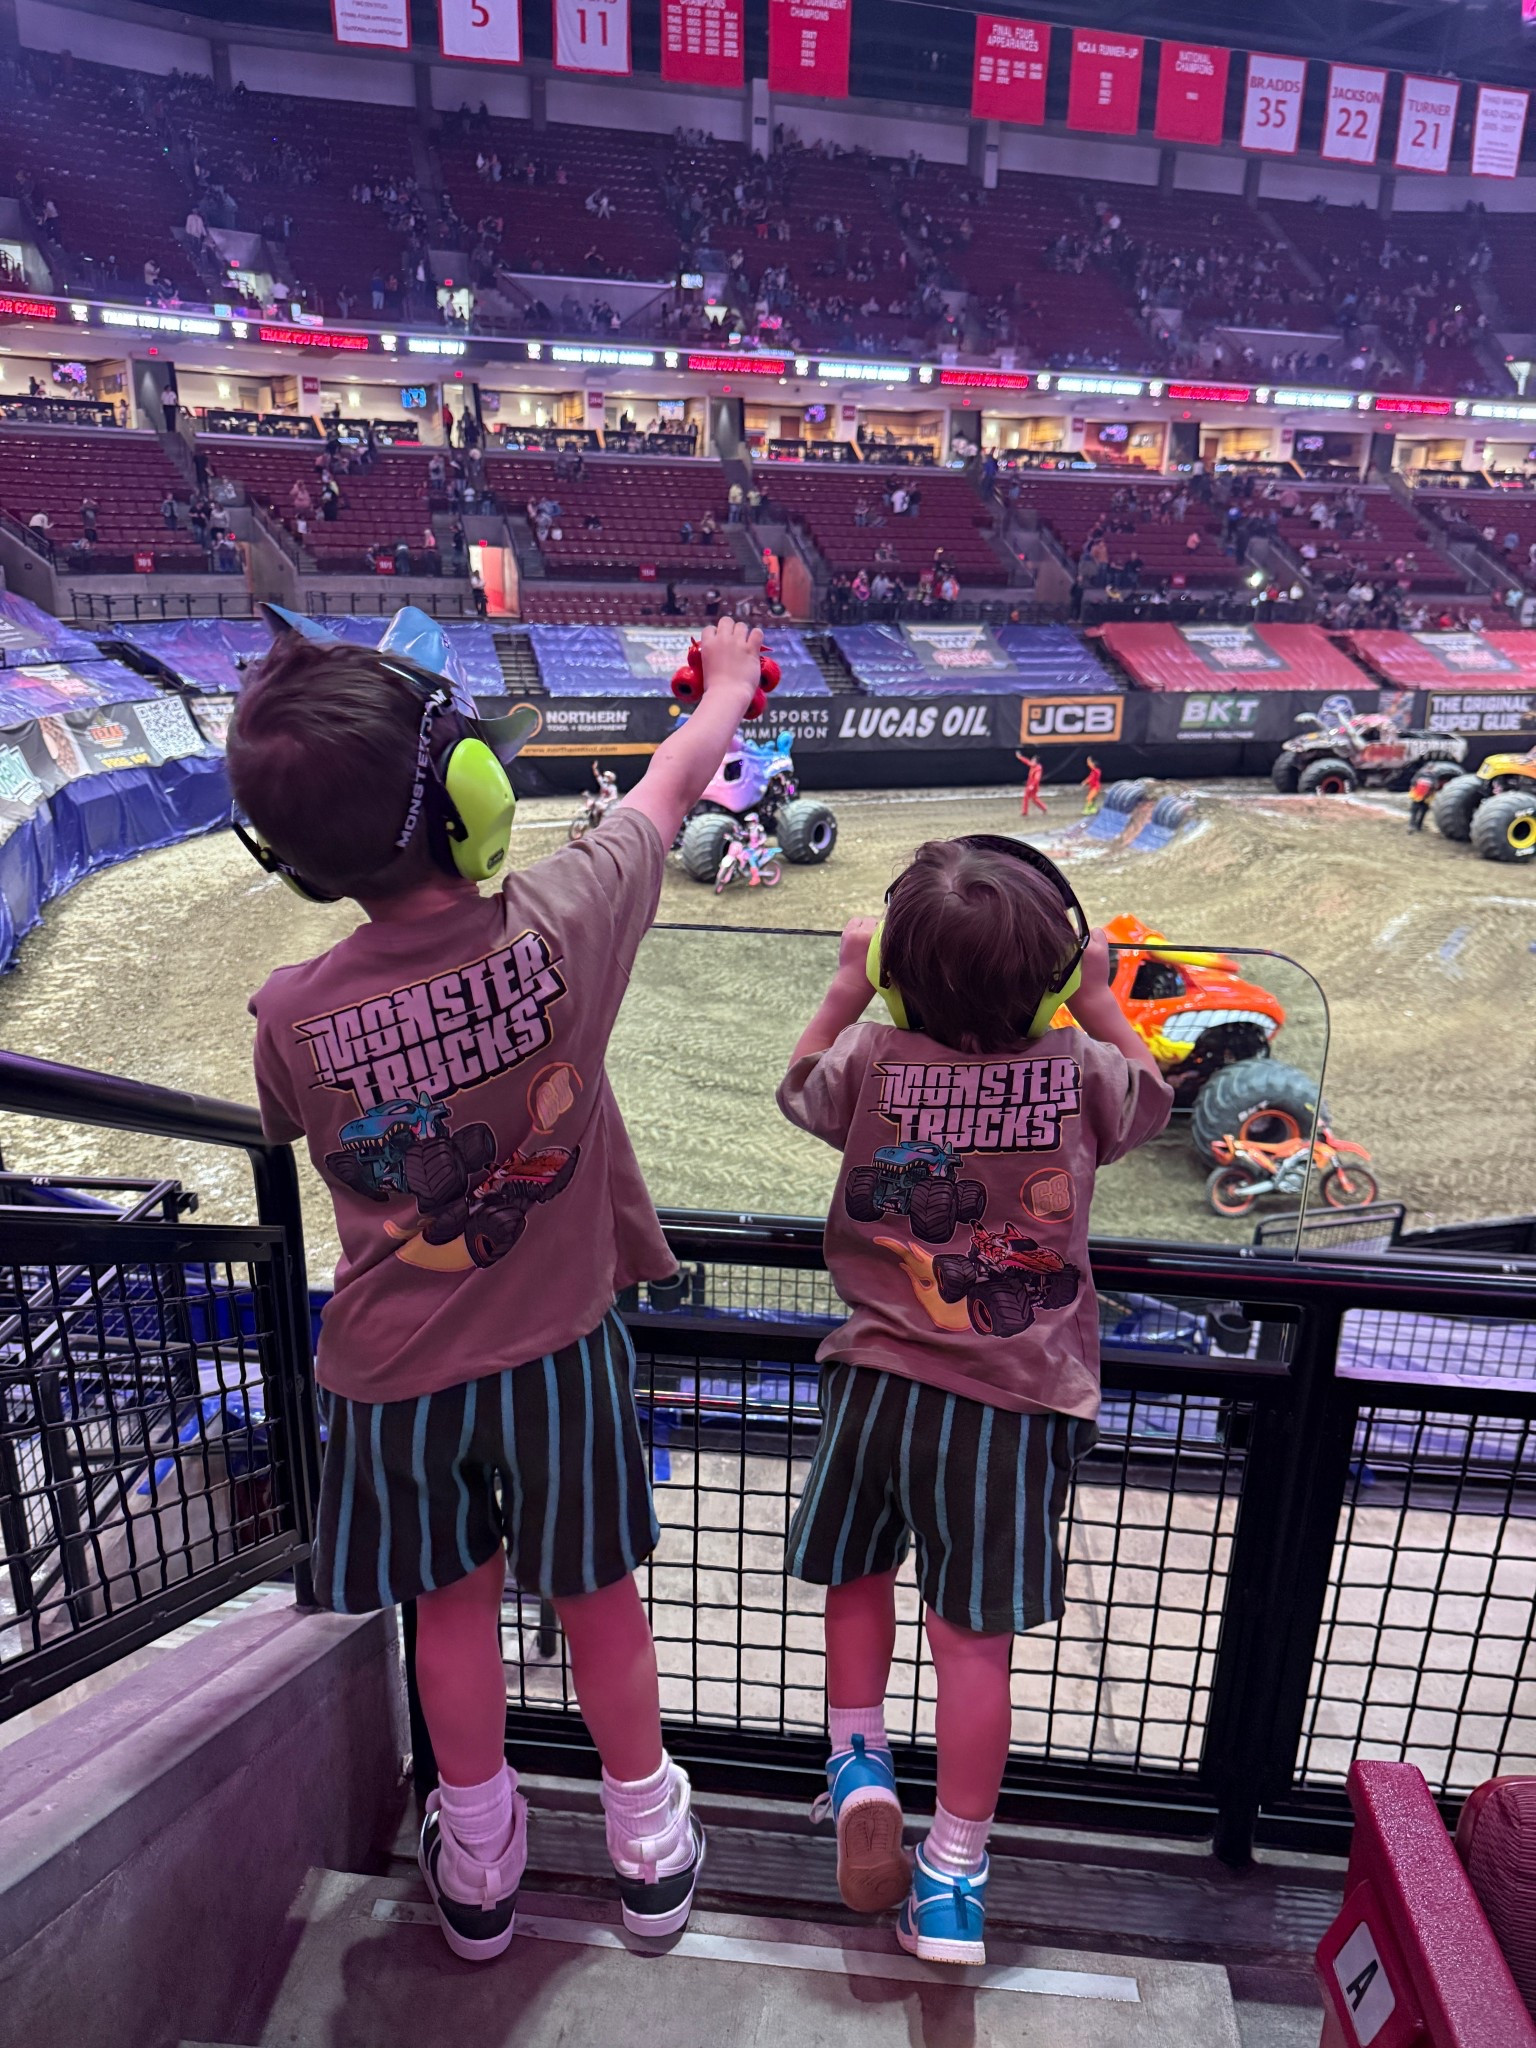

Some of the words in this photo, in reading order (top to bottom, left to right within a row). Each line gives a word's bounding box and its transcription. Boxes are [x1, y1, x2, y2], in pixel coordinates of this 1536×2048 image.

[472, 0, 490, 28] 5
[790, 6, 829, 21] CHAMPIONS
[576, 8, 607, 47] 11
[993, 24, 1012, 37] FINAL
[1015, 27, 1035, 40] FOUR
[987, 35, 1039, 53] APPEARANCES
[1077, 41, 1097, 54] NCAA
[1098, 43, 1139, 59] RUNNER-UP
[1175, 60, 1215, 76] CHAMPIONS
[1179, 50, 1211, 65] NATIONAL
[1250, 76, 1301, 93] BRADDS
[1332, 86, 1382, 104] JACKSON
[1256, 96, 1288, 129] 35
[1408, 99, 1451, 117] TURNER
[1335, 107, 1369, 140] 22
[1411, 119, 1441, 150] 21
[14, 301, 58, 319] COMING
[260, 327, 291, 344] THANK
[292, 330, 310, 346] YOU
[310, 332, 331, 348] FOR
[332, 334, 369, 351] COMING
[1183, 700, 1260, 723] BKT
[1431, 695, 1462, 713] THE
[1462, 695, 1531, 713] ORIGINAL
[545, 711, 629, 723] NORTHERN
[770, 710, 829, 723] SPORTS
[838, 706, 939, 739] LUCAS
[941, 706, 988, 738] OIL
[1029, 705, 1115, 735] JCB
[1429, 713, 1480, 732] SUPER
[1482, 713, 1521, 731] GLUE
[547, 724, 570, 732] TOOL
[577, 724, 628, 732] EQUIPMENT
[744, 726, 828, 739] MMISSION
[397, 736, 431, 848] MONSTER
[296, 932, 562, 1088] MONSTER
[337, 995, 546, 1117] TRUCKS
[872, 1056, 1081, 1114] MONSTER
[890, 1102, 1059, 1149] TRUCKS
[1031, 1174, 1071, 1217] 68
[1345, 1958, 1379, 2013] A
